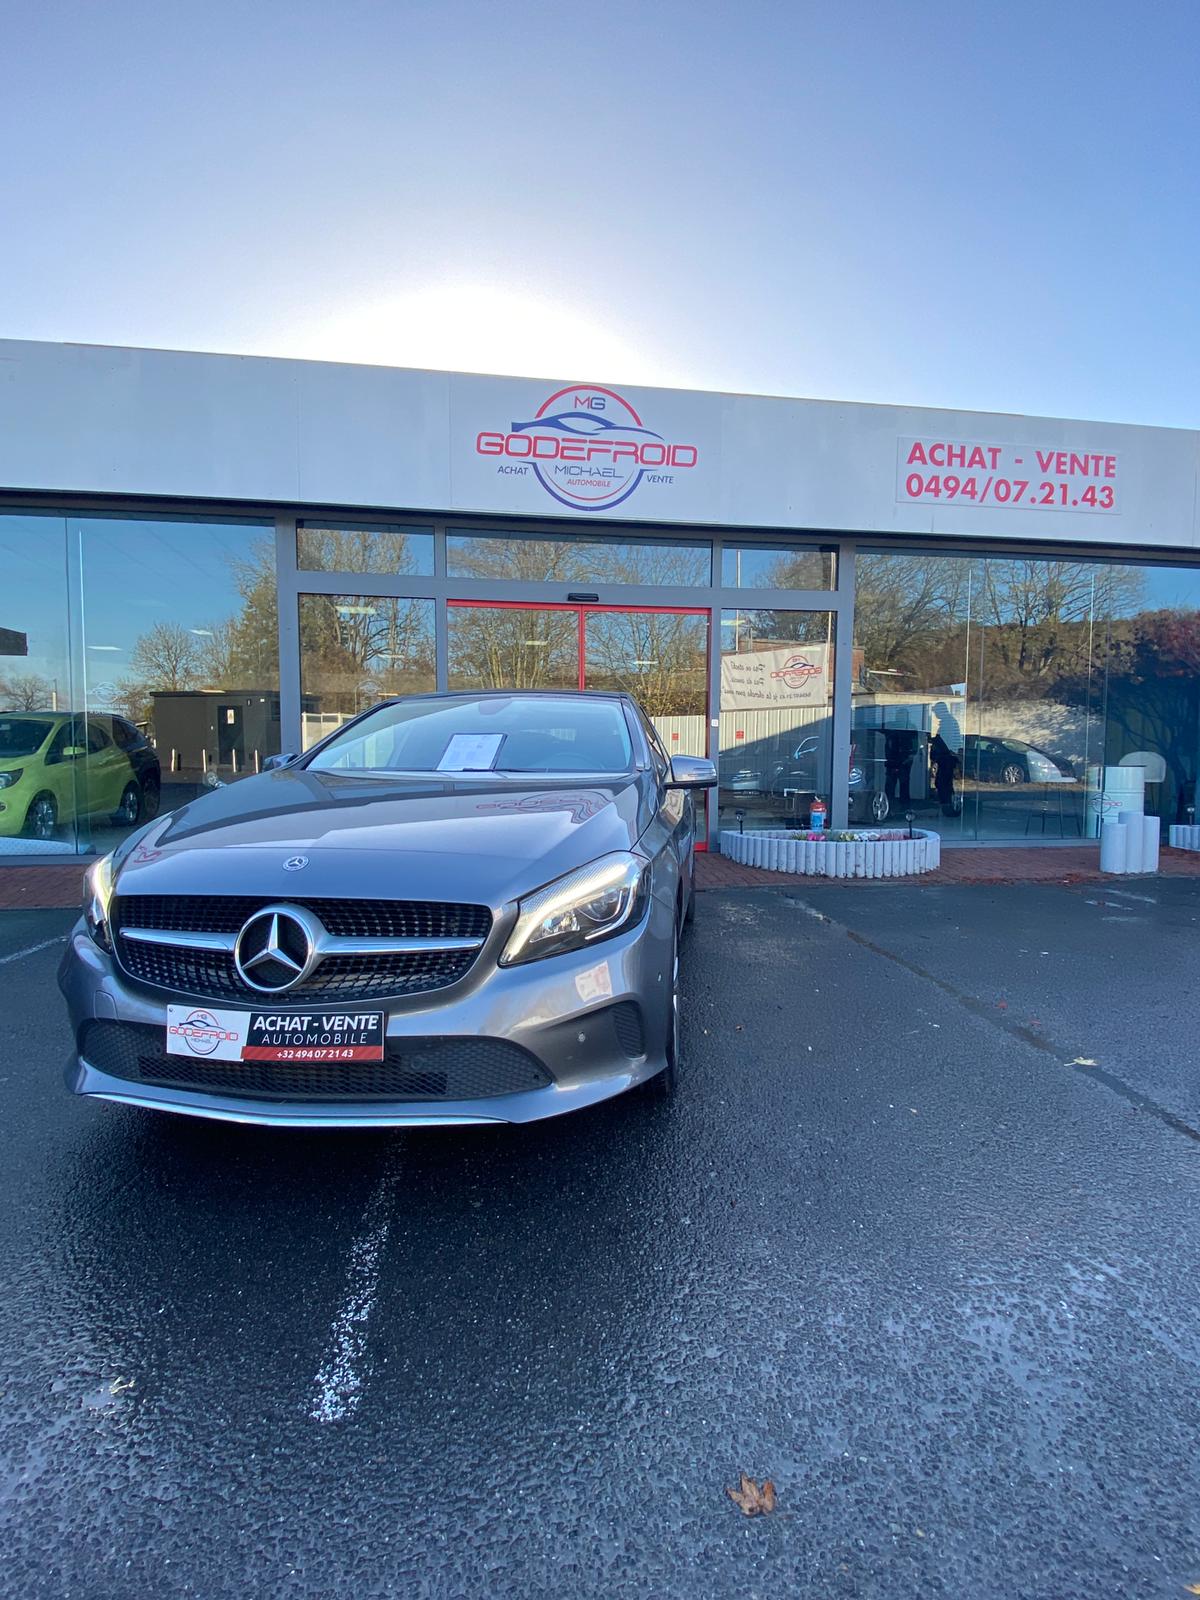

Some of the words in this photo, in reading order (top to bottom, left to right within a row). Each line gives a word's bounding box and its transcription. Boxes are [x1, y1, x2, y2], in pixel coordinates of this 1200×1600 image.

[574, 396, 606, 410] MG
[476, 432, 698, 468] GODEFROID
[907, 442, 1002, 470] ACHAT
[1035, 451, 1117, 478] VENTE
[497, 465, 529, 475] ACHAT
[554, 465, 624, 478] MICHAEL
[567, 479, 611, 487] AUTOMOBILE
[647, 475, 674, 484] VENTE
[905, 473, 1114, 509] 0494/07.21.43
[261, 1033, 368, 1045] AUTOMOBILE
[277, 1050, 294, 1058] +32
[295, 1050, 313, 1058] 494
[314, 1050, 327, 1058] 07
[328, 1050, 339, 1058] 21
[341, 1049, 354, 1058] 43
